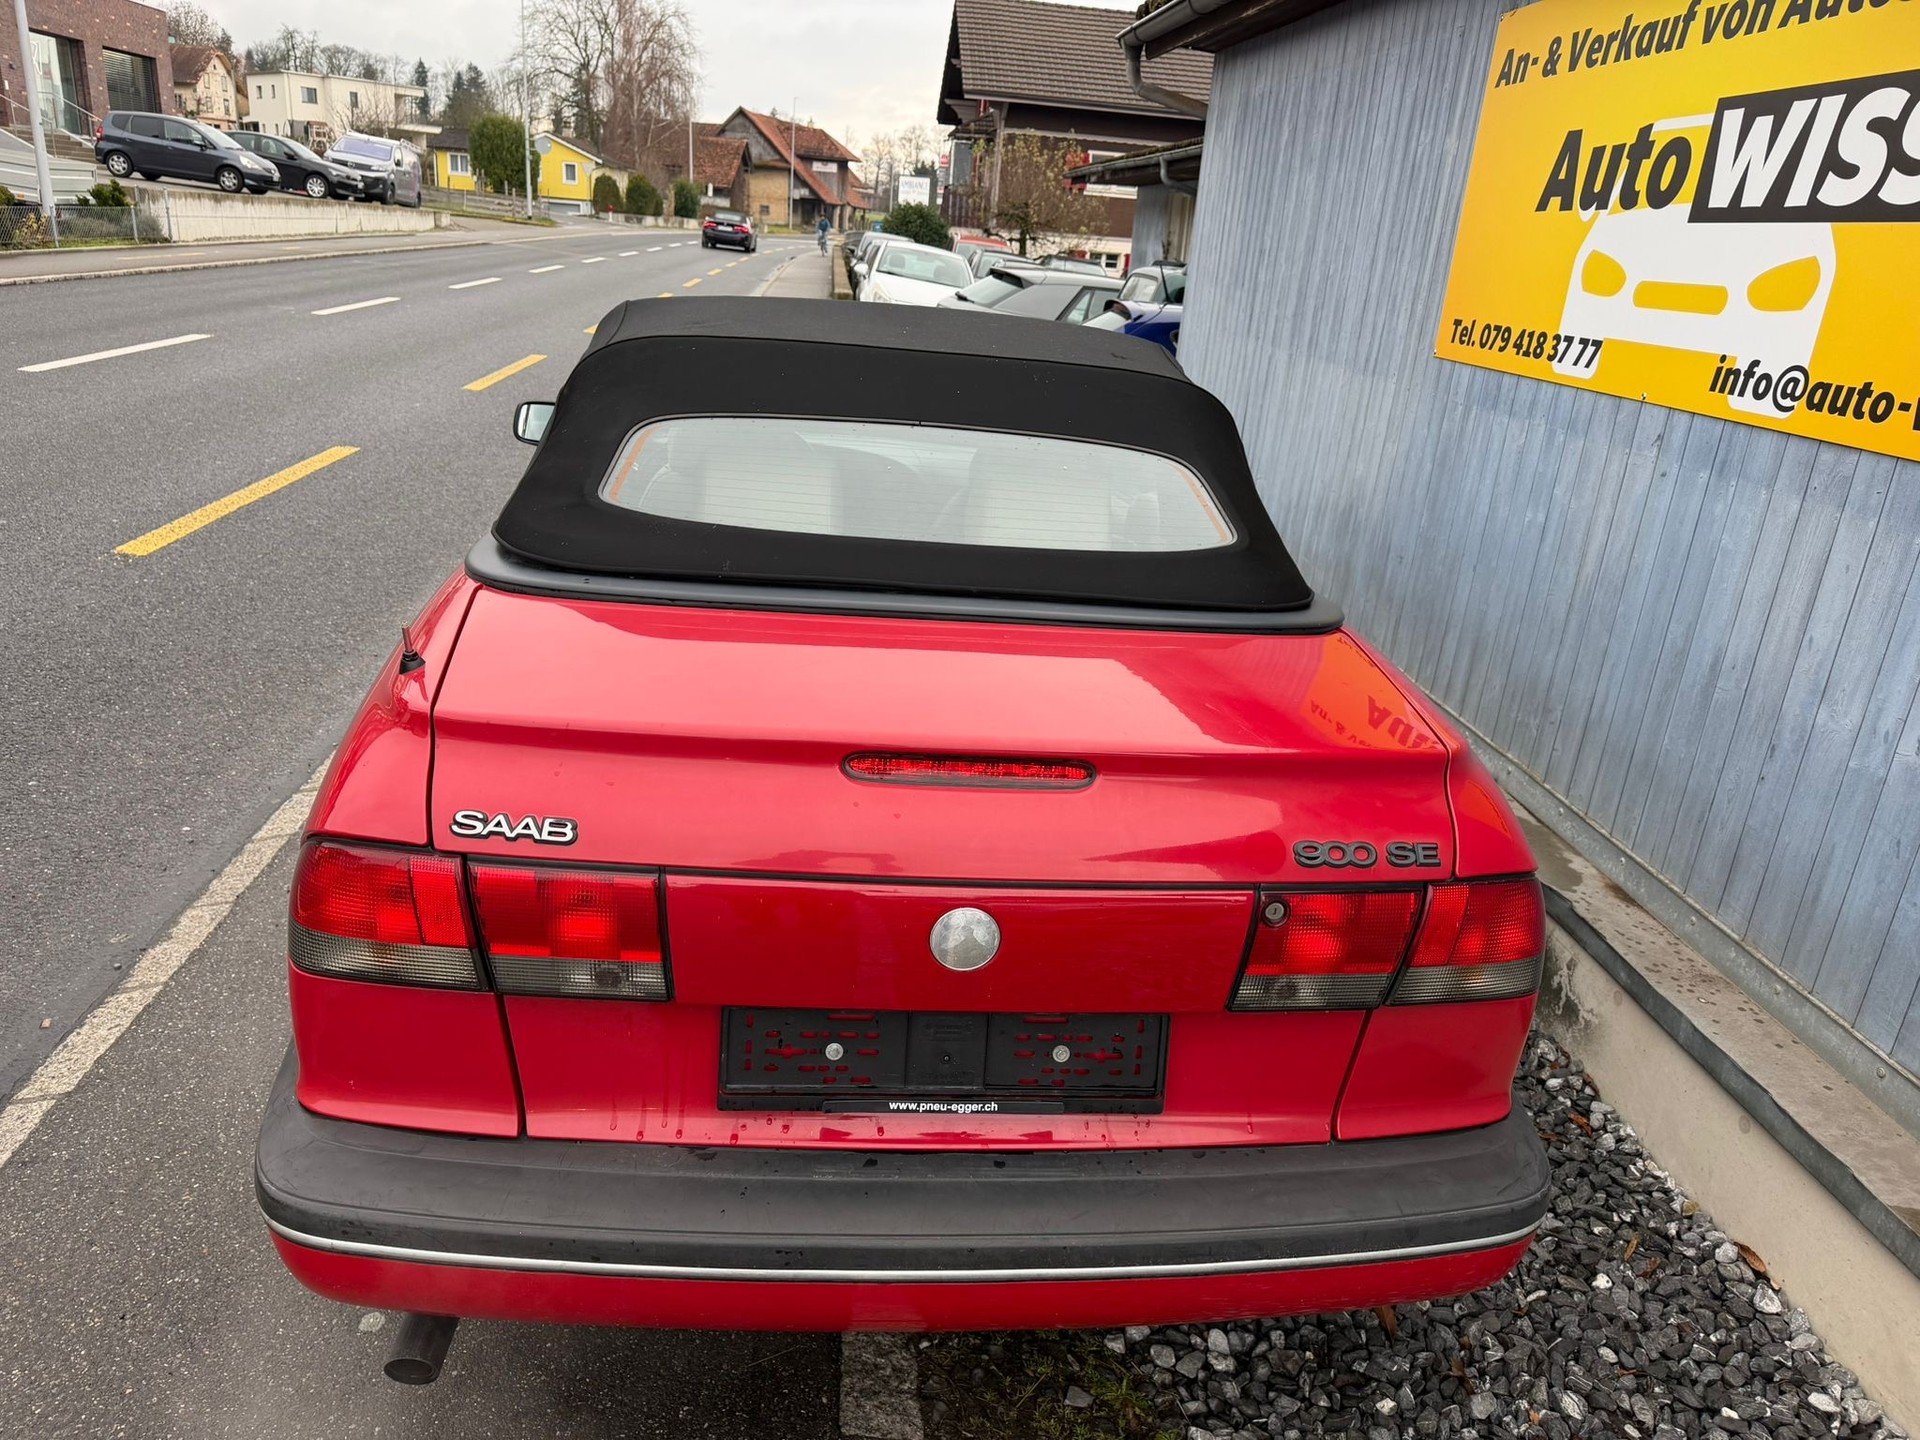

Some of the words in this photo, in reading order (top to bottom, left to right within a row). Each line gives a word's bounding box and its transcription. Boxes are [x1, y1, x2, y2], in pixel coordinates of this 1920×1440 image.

[1494, 48, 1539, 88] An-
[1542, 36, 1562, 78] &
[1568, 0, 1701, 73] Verkauf
[1702, 0, 1777, 45] von
[1535, 122, 1692, 213] Auto
[1450, 318, 1476, 348] Tel.
[1479, 323, 1512, 353] 079
[1512, 328, 1548, 360] 418
[1547, 333, 1575, 363] 37
[1572, 337, 1603, 369] 77
[1708, 354, 1920, 431] info@auto-
[450, 810, 578, 846] SAAB
[1293, 840, 1377, 869] 900
[1386, 842, 1441, 868] SE
[888, 1101, 998, 1113] www.pneu-egger.ch
